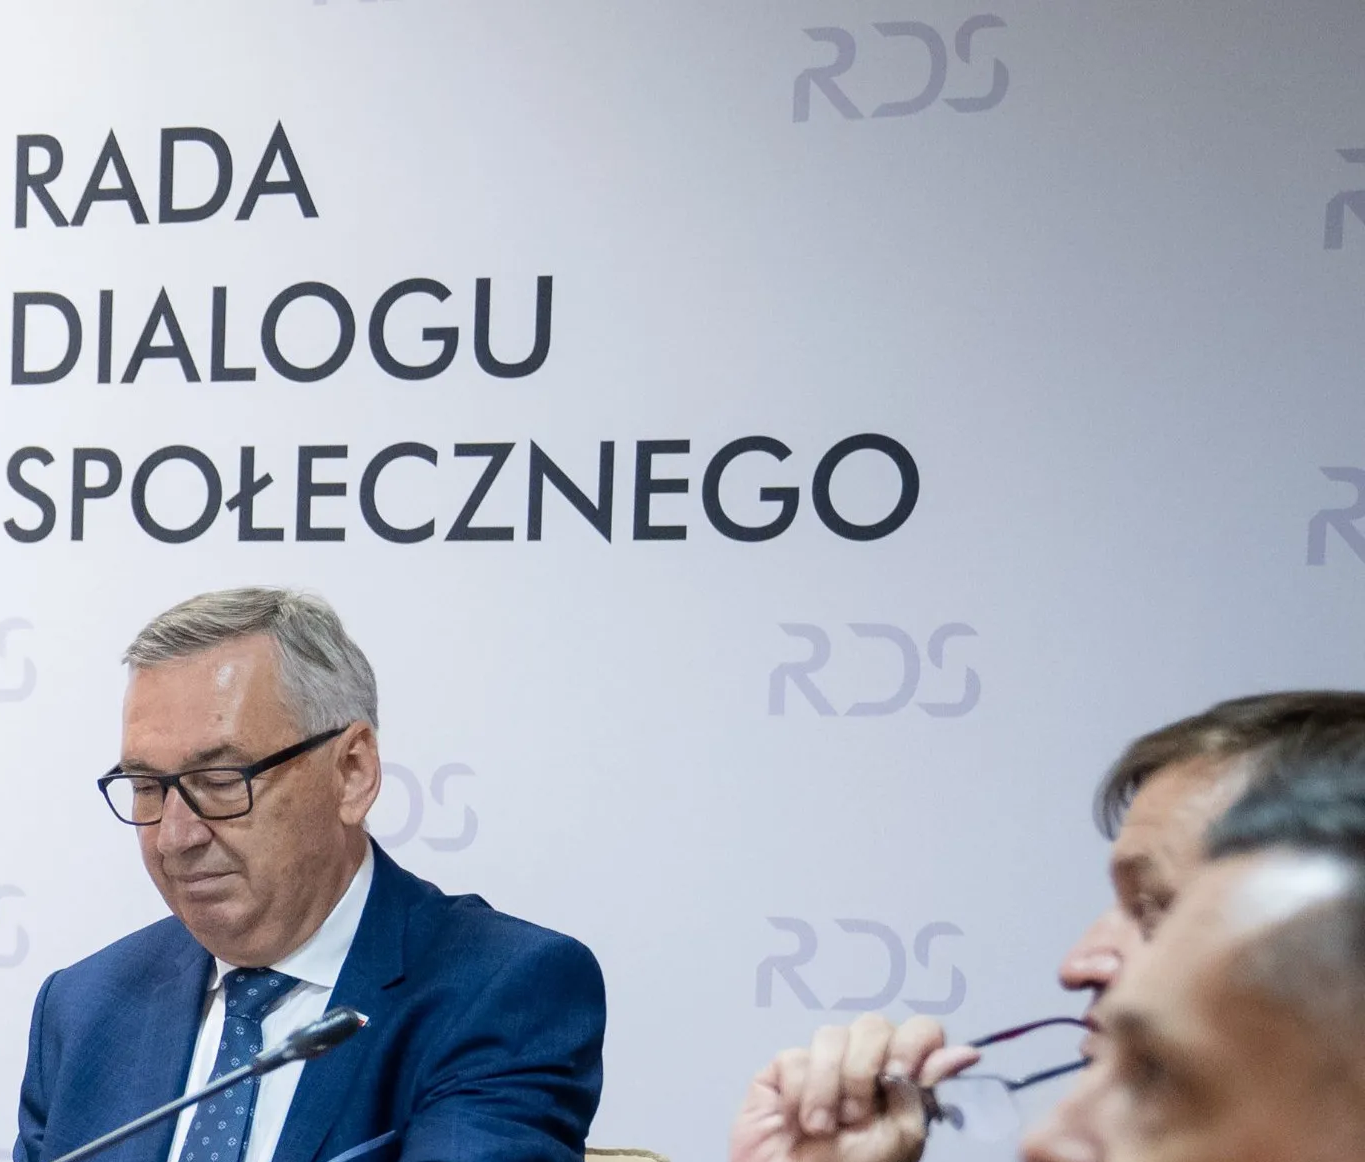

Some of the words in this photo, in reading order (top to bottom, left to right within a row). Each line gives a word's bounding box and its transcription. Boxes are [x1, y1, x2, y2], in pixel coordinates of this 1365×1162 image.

[791, 13, 1010, 123] RDS
[14, 119, 320, 230] RADA
[10, 274, 554, 387] DIALOGU
[3, 432, 921, 546] SPOŁECZNEGO
[768, 622, 982, 718] RDS
[366, 761, 479, 853] DS
[755, 917, 968, 1015] RDS
